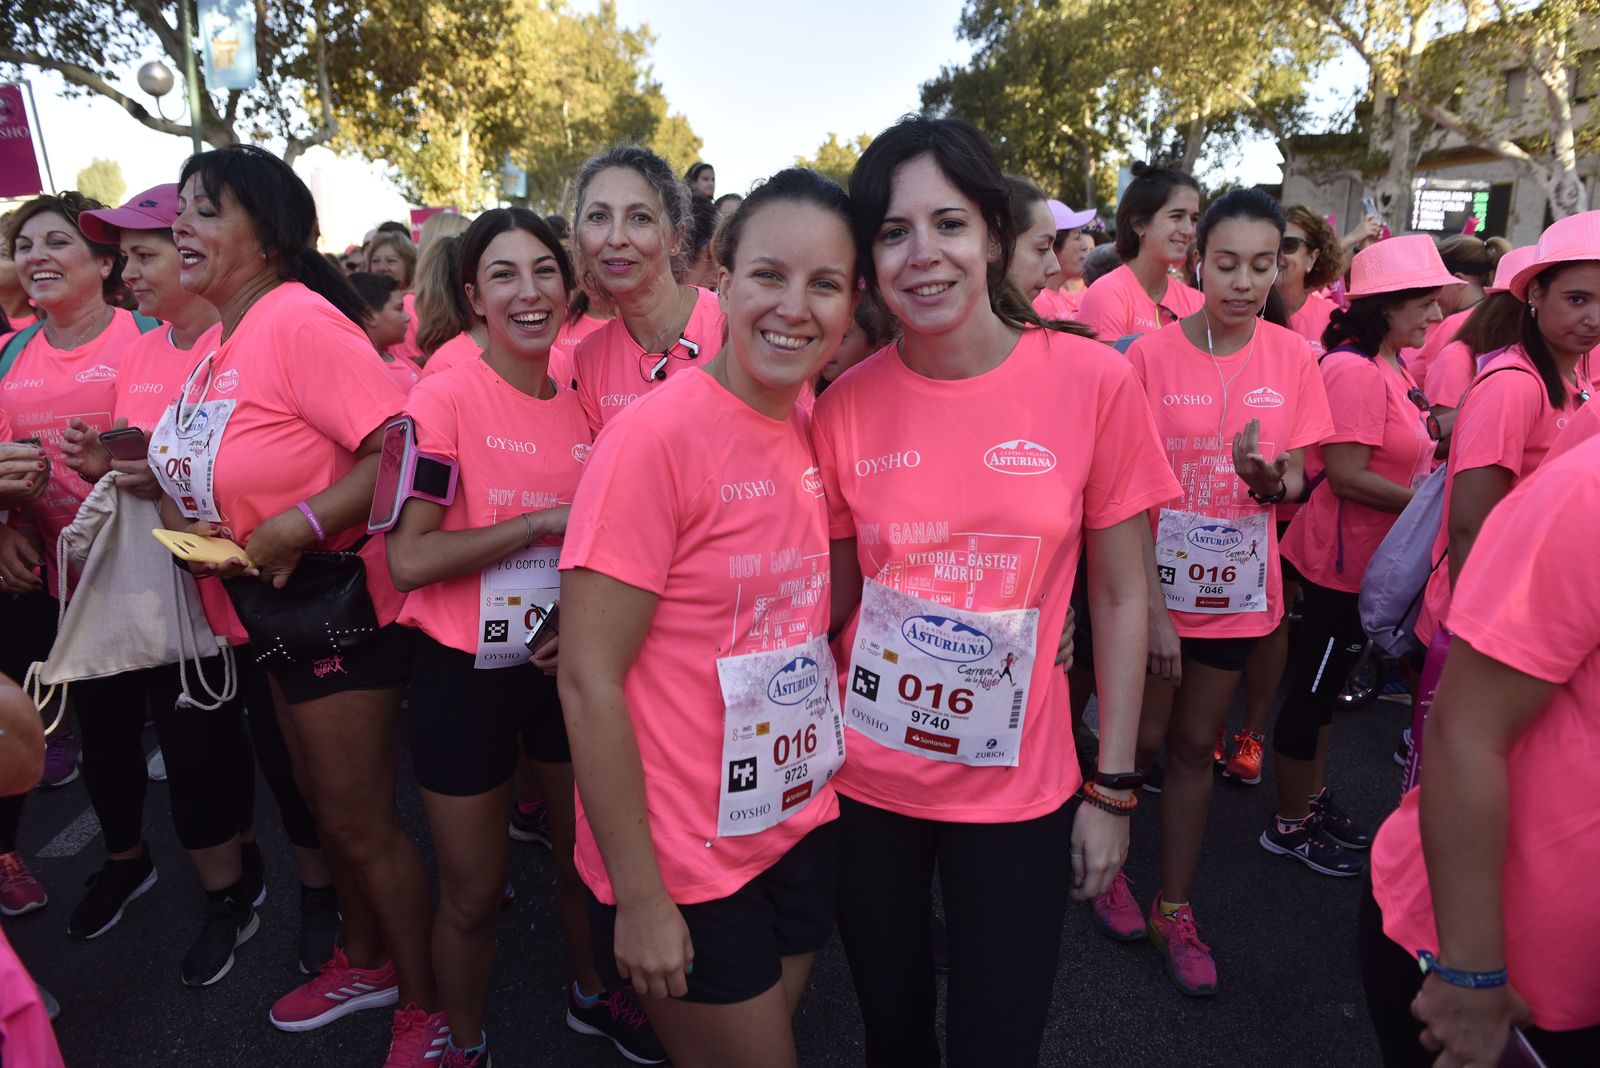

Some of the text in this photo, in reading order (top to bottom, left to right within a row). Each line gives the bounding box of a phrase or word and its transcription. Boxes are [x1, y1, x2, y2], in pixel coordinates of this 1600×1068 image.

[0, 126, 29, 138] SHO
[1163, 394, 1212, 405] OYSHO
[1246, 395, 1282, 404] ASTURIANA
[486, 433, 537, 455] OYSHO
[855, 449, 921, 478] OYSHO
[989, 452, 1051, 467] ASTURIANA
[488, 488, 516, 506] HOY
[720, 479, 776, 504] OYSHO
[888, 521, 950, 545] GANAN
[1191, 531, 1239, 547] ASTURIANA
[515, 559, 546, 570] corro
[729, 555, 761, 579] HOY
[908, 551, 955, 566] VITORIA
[967, 553, 1018, 570] GASTEIZ
[934, 564, 984, 581] MADRID
[1188, 563, 1237, 583] 016
[1199, 586, 1224, 595] 7046
[906, 622, 985, 656] ASTURIANA
[484, 653, 520, 661] OYSHO
[957, 664, 994, 676] Carrera
[772, 673, 817, 698] ASTURIANA
[977, 675, 1001, 692] Mujer
[898, 673, 975, 715] 016
[851, 707, 889, 733] OYSHO
[911, 710, 950, 731] 9740
[773, 723, 817, 766] 016
[920, 737, 952, 749] Santander
[784, 763, 808, 784] 9723
[729, 803, 771, 821] OYSHO
